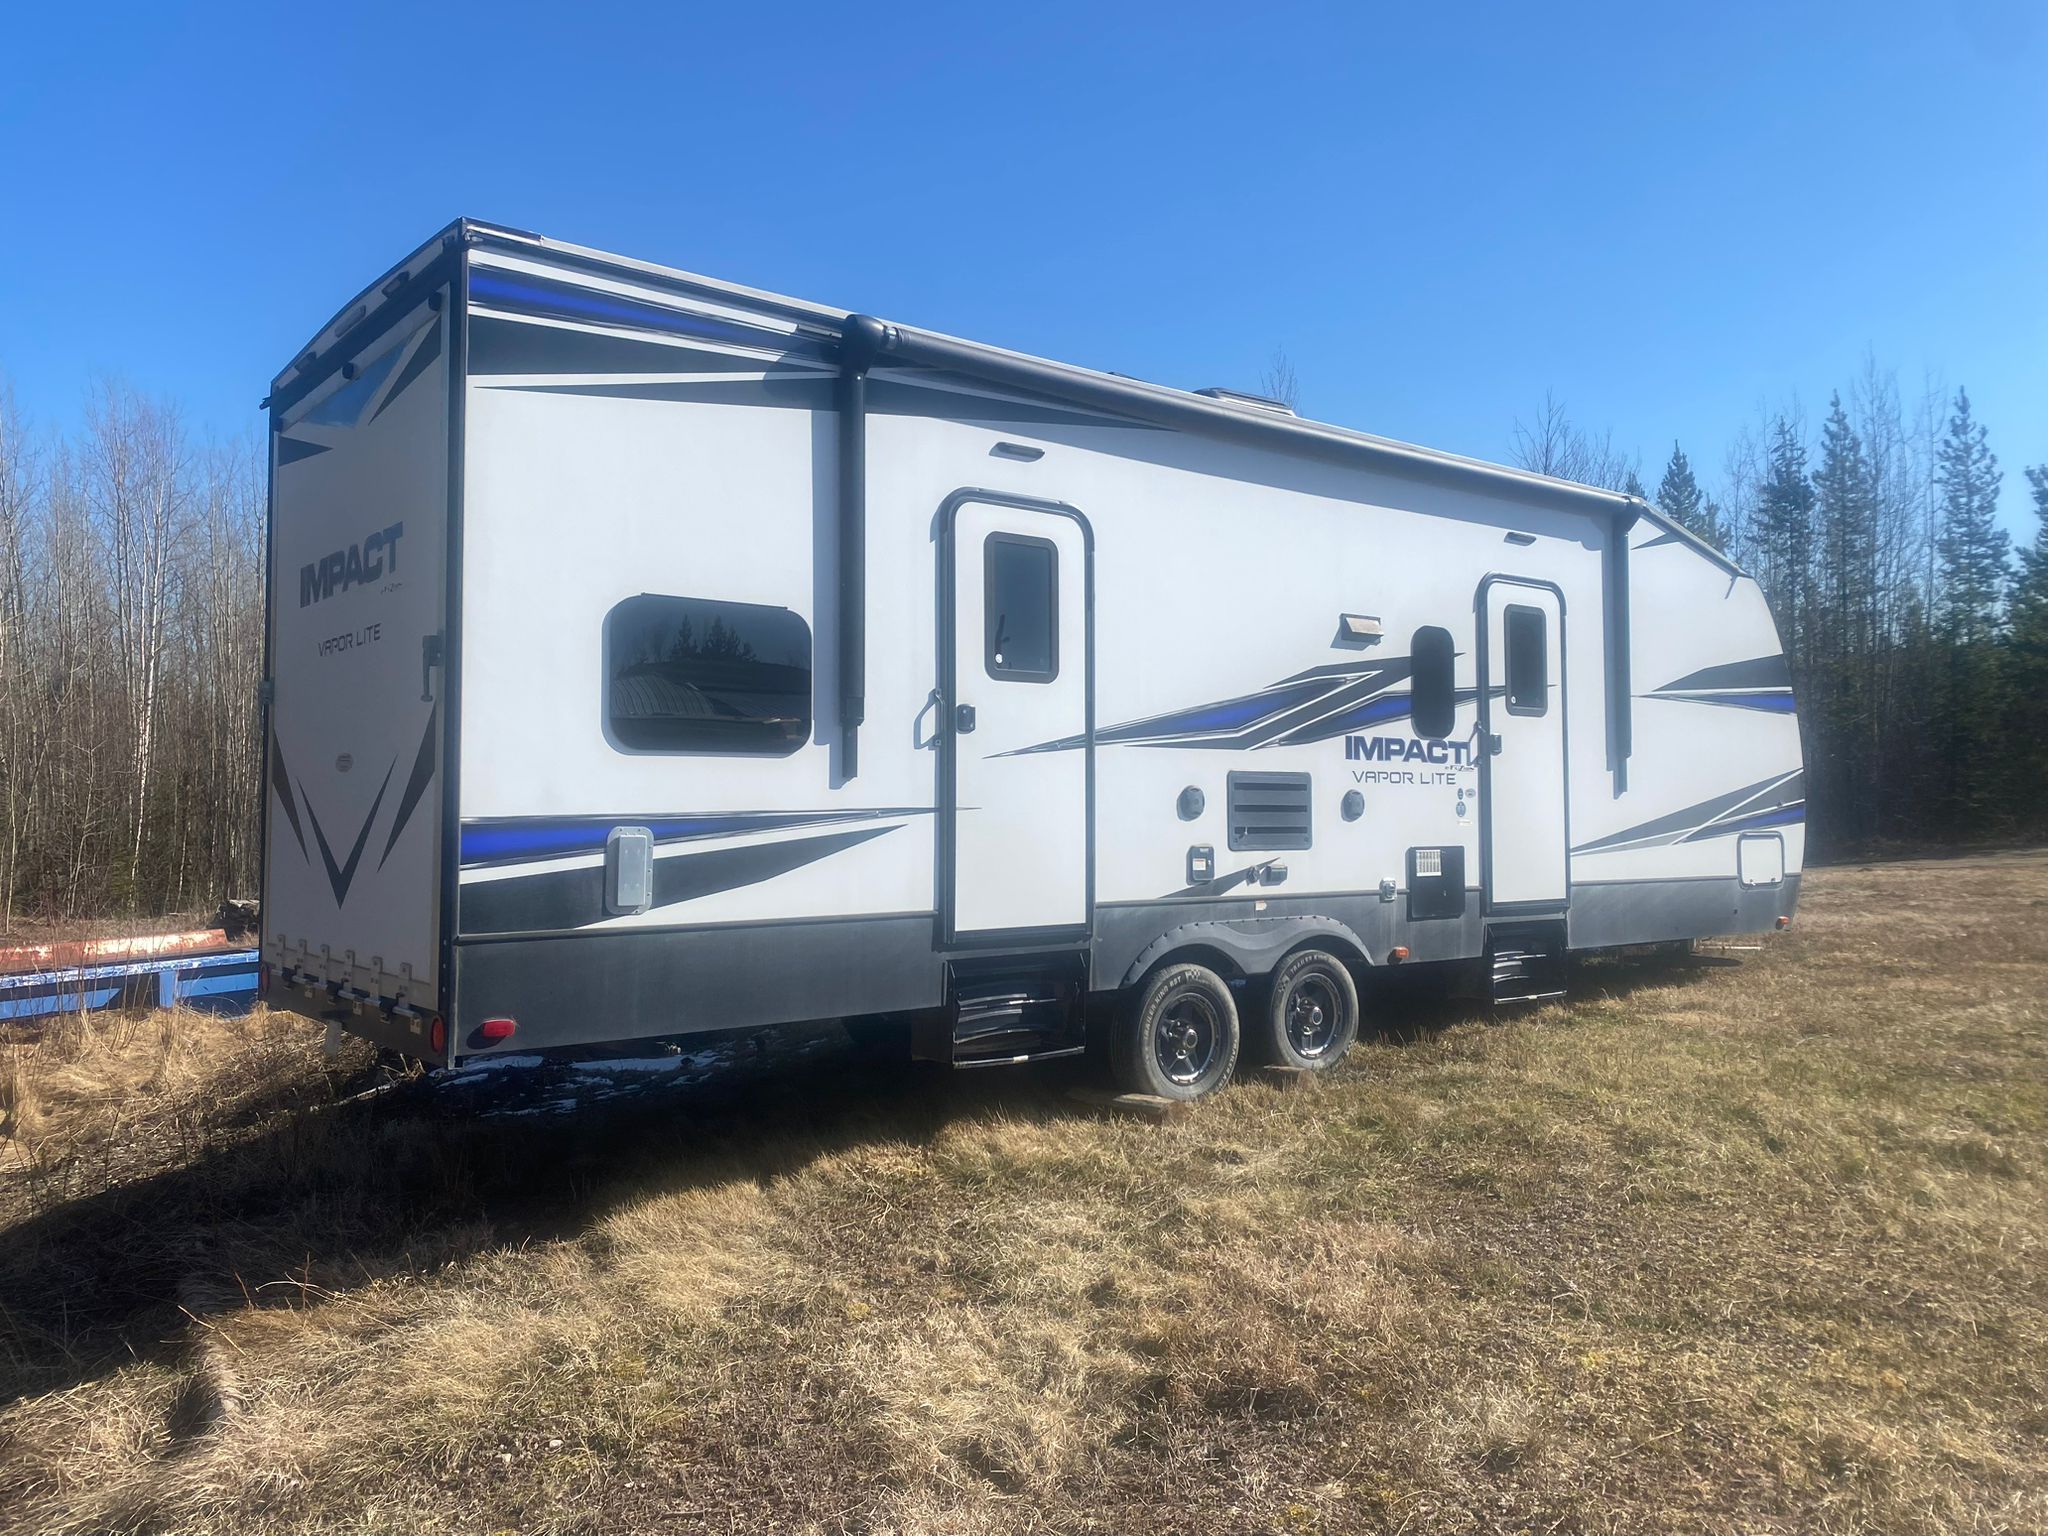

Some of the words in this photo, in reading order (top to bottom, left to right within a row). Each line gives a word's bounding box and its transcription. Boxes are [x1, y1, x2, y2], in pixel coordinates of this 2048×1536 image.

[300, 521, 403, 608] IMPACT
[318, 633, 353, 657] VAPOR
[356, 623, 382, 647] LITE
[1345, 735, 1470, 764] IMPACT
[1352, 770, 1414, 785] VAPOR
[1420, 772, 1456, 785] LITE
